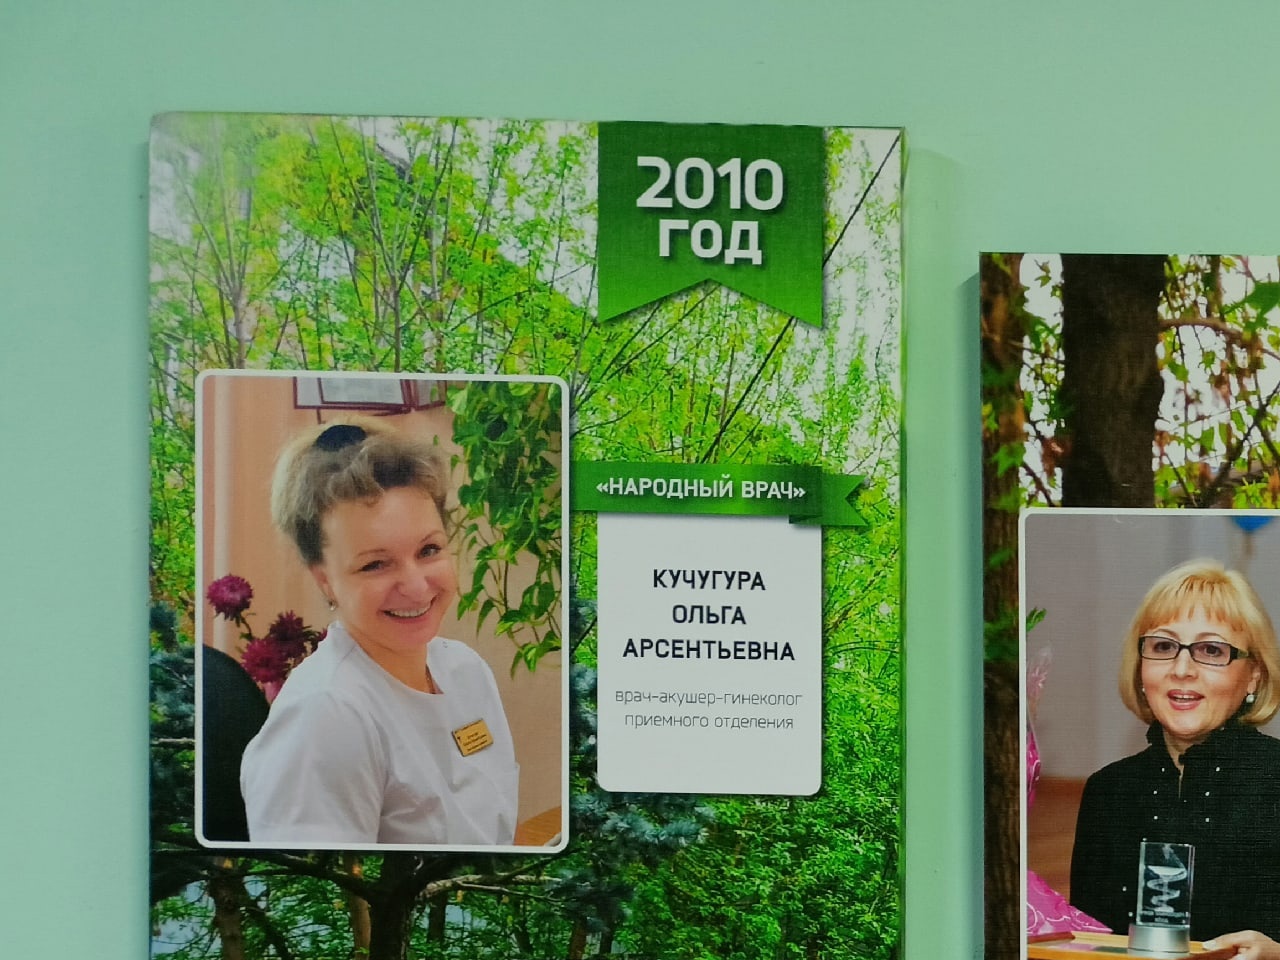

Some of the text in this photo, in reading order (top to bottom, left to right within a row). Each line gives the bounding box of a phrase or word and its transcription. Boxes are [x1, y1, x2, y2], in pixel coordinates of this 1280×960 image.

[636, 156, 783, 210] 2010
[596, 474, 806, 499] «НАРОДНЫЙ ВРАЧ»
[653, 569, 766, 590] КУЧУГУРА
[672, 605, 746, 625] ОЛЬГА
[622, 639, 795, 660] АРСЕНТЬЕВНА
[615, 690, 802, 706] врач-акушер-гинеколог
[625, 713, 794, 729] приемного отделения
